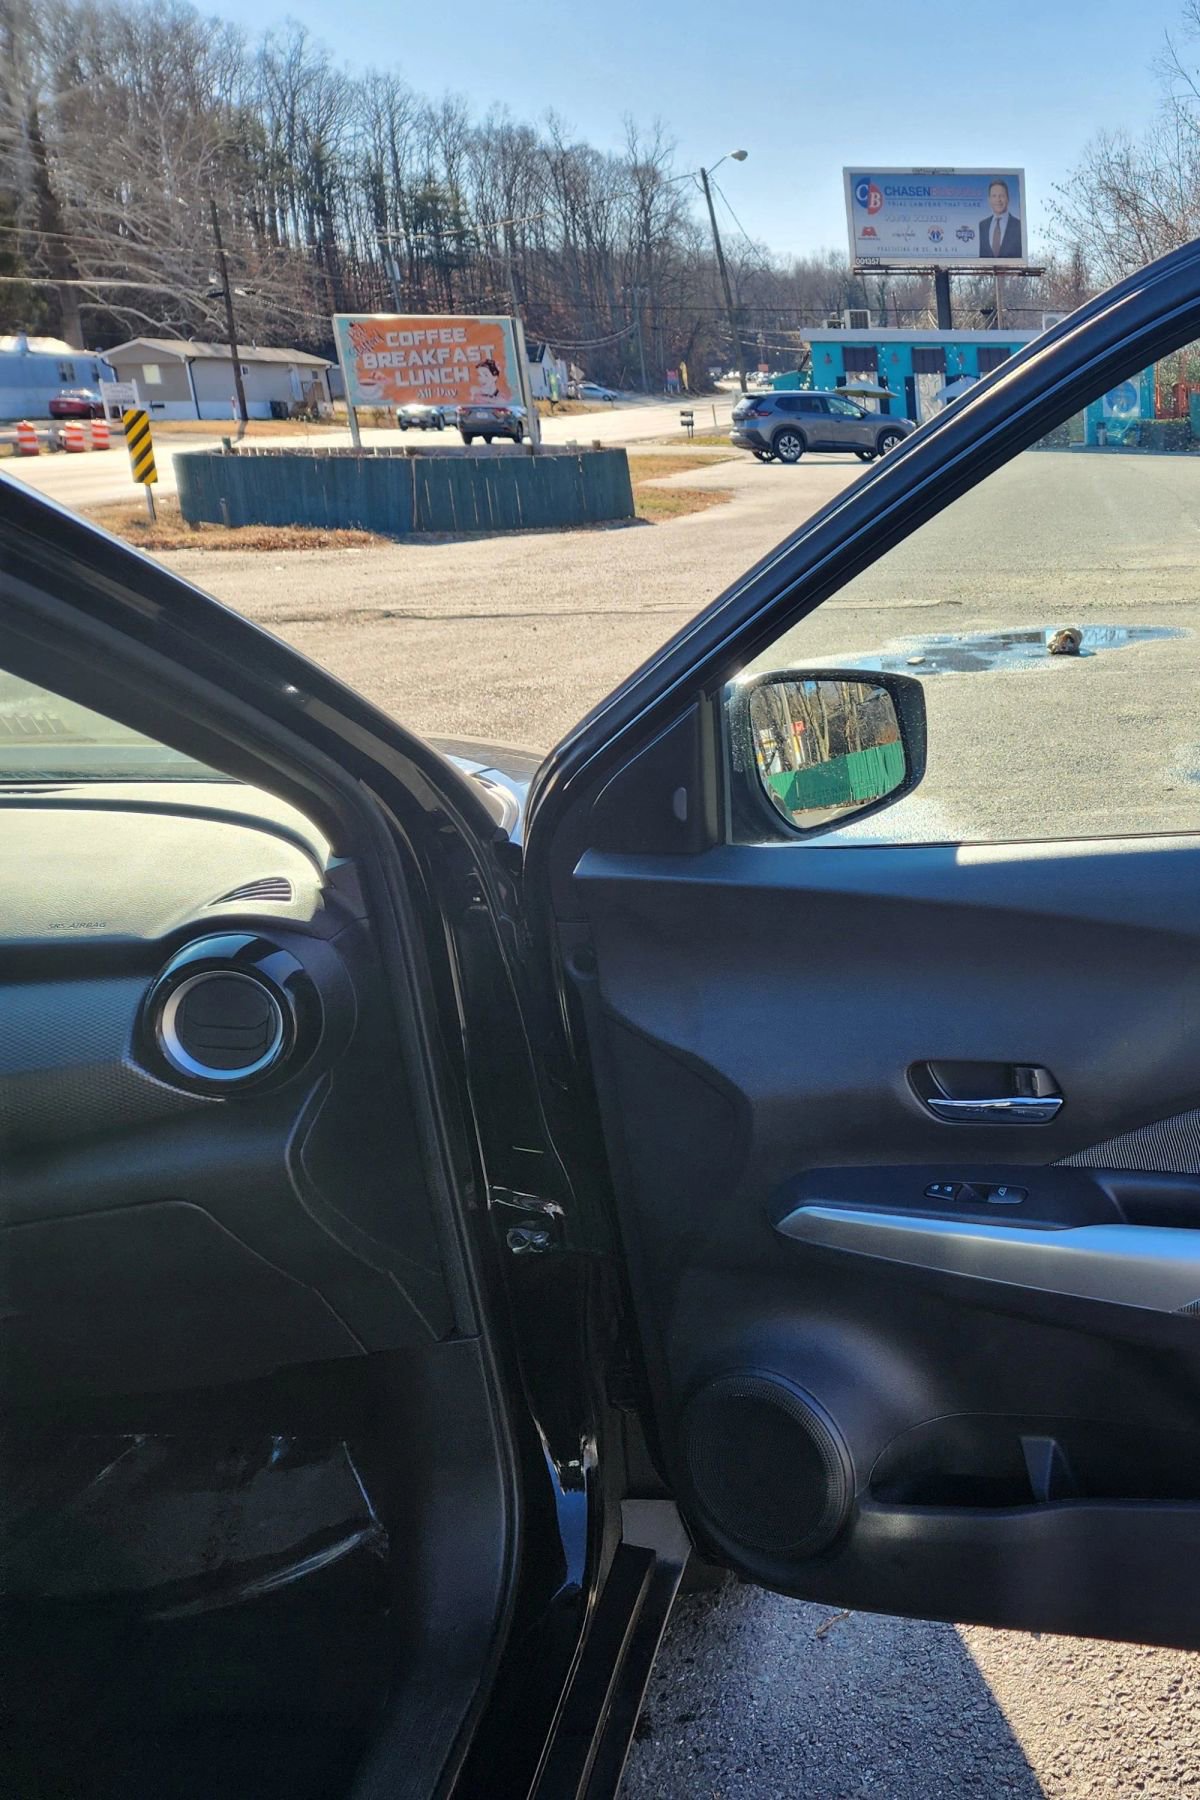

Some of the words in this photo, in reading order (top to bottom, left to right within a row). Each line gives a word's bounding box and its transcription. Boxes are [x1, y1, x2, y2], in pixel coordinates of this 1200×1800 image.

[385, 328, 467, 347] COFFEE
[364, 345, 495, 369] BREAKFAST
[395, 366, 470, 386] LUNCH
[416, 388, 432, 399] All
[436, 387, 458, 400] Day
[68, 921, 106, 929] AIRBAG
